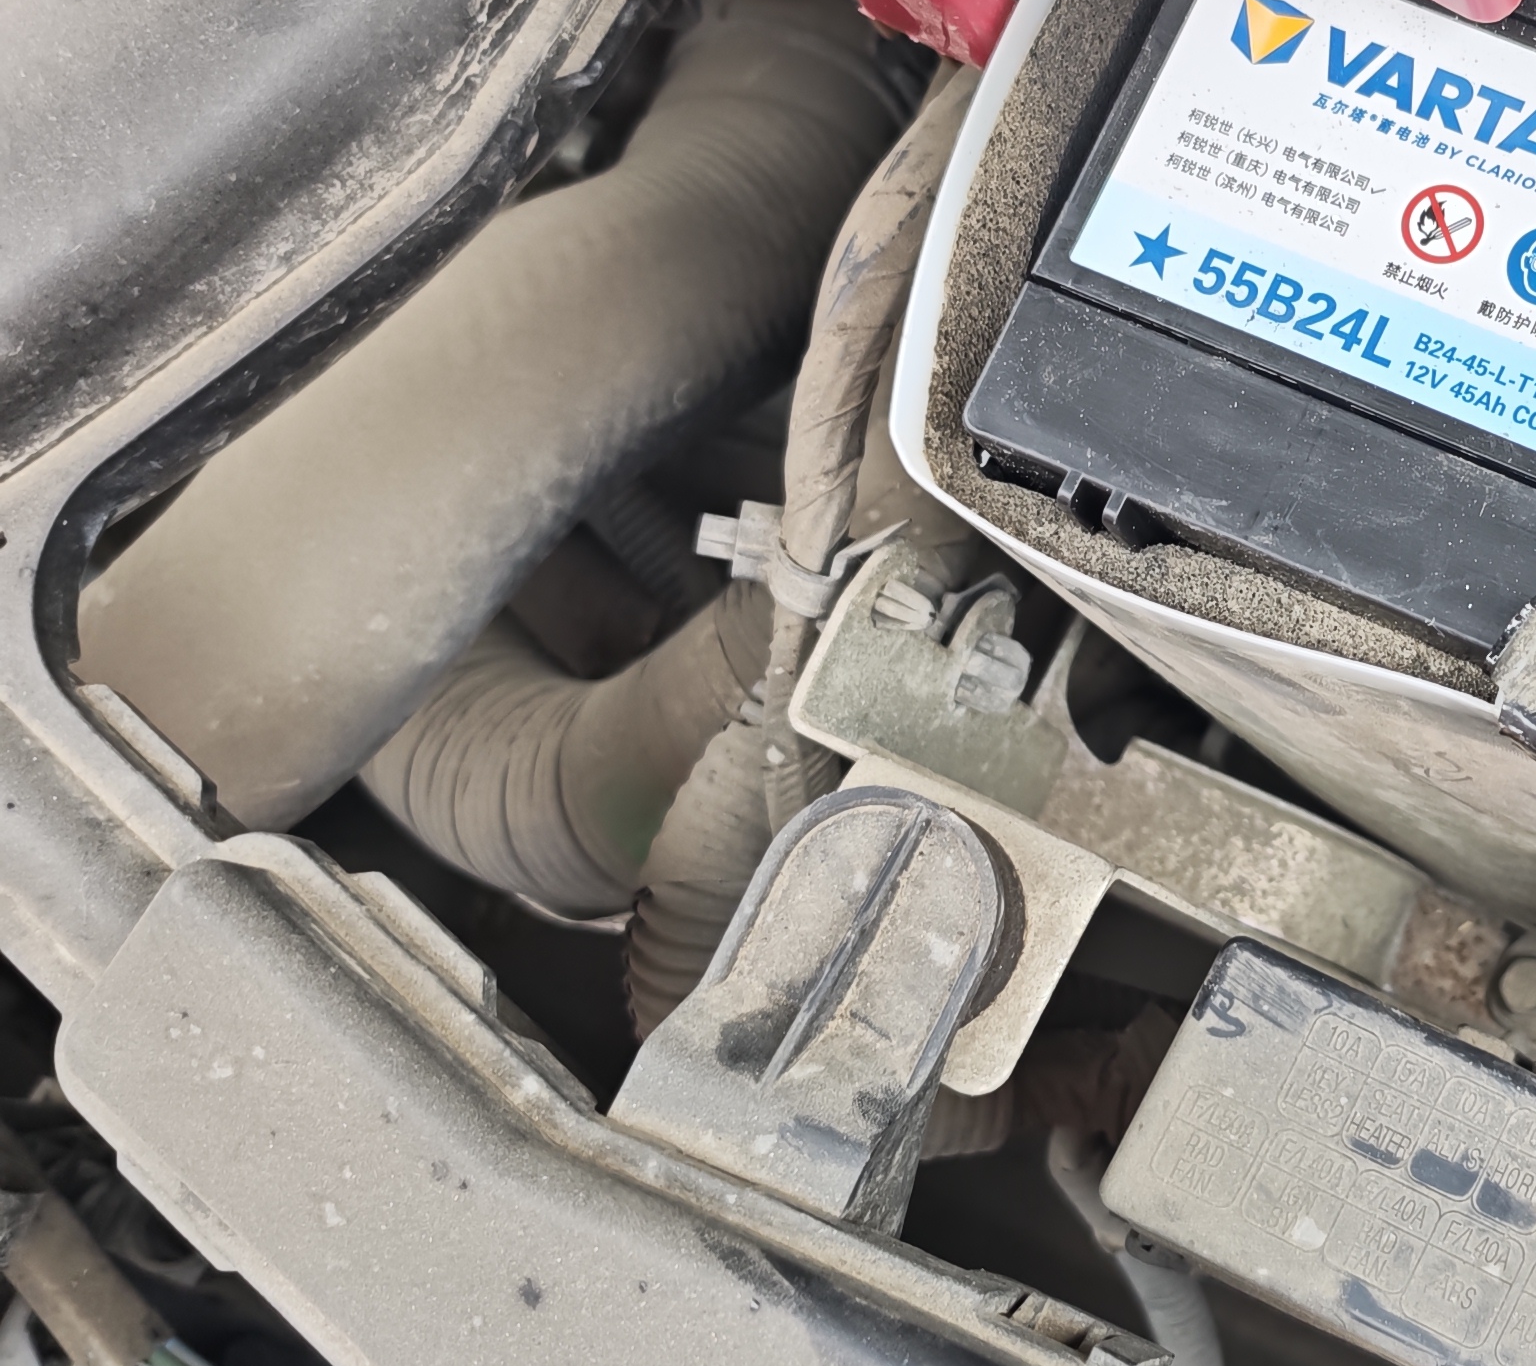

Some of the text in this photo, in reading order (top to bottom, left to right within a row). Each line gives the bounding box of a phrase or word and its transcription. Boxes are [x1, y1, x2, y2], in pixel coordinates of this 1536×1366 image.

[1433, 140, 1462, 164] BY
[1381, 259, 1450, 301] 禁止烟火
[1189, 244, 1406, 370] 55B24L
[1402, 358, 1448, 393] 12V
[1447, 377, 1507, 418] 45Ah
[1322, 1024, 1365, 1061] 10A
[1304, 1059, 1348, 1096] KEY
[1365, 1086, 1421, 1129] SEAT
[1181, 1132, 1228, 1170] RAD
[1345, 1110, 1414, 1159] HEATER
[1168, 1156, 1215, 1195] FAN
[1441, 1218, 1516, 1271] F/L40A
[1432, 1272, 1479, 1311] ABS
